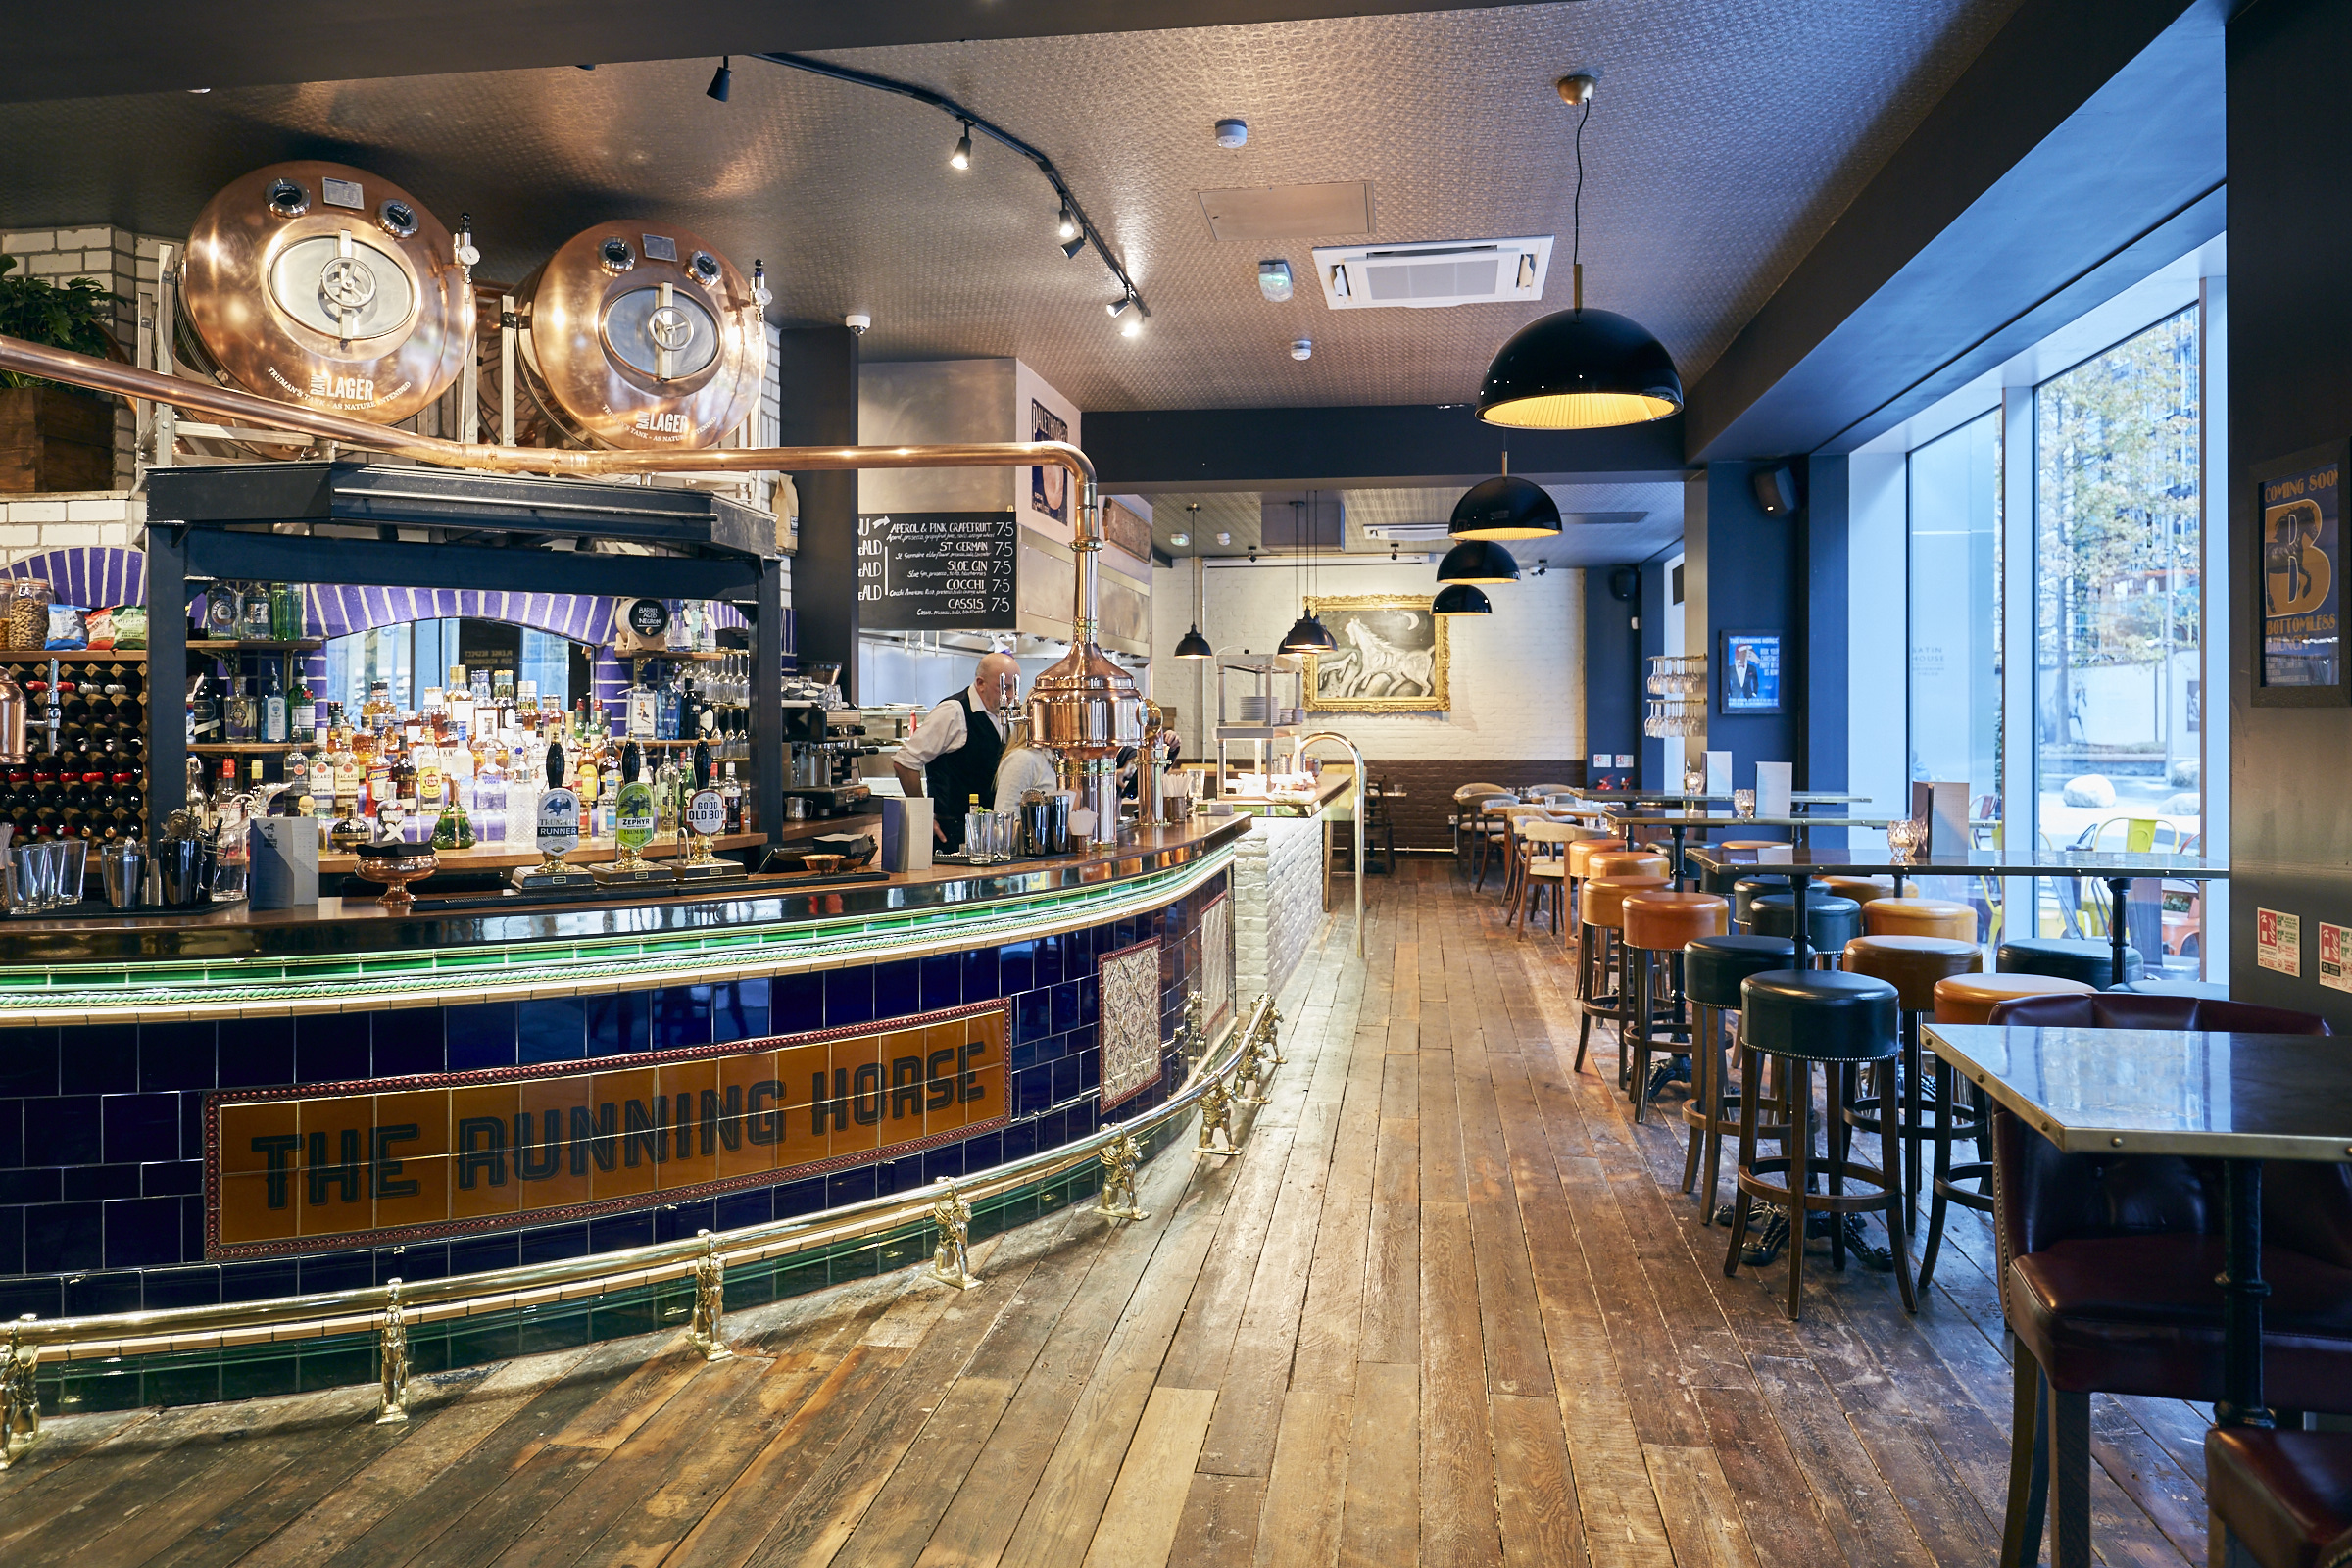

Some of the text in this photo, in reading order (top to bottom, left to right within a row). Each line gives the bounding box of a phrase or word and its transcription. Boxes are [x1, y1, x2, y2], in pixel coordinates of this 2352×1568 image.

[268, 366, 303, 398] TRUMAN'S
[304, 394, 325, 407] TANK
[344, 402, 376, 411] NATURE
[378, 380, 412, 406] INTENDED
[310, 373, 326, 396] RAW
[326, 375, 374, 401] LAGER
[635, 410, 651, 430] RAW
[649, 412, 689, 433] LAGER
[630, 428, 649, 439] TANK
[2265, 478, 2305, 503] COMING
[890, 523, 919, 533] APEROL
[921, 522, 927, 532] &
[929, 522, 947, 533] PINK
[949, 522, 992, 532] GRAPEFRUIT
[939, 542, 953, 552] ST
[956, 541, 988, 551] GERMAN
[947, 560, 969, 571] SLOE
[971, 560, 988, 571] GIN
[946, 578, 985, 590] COCCHI
[948, 598, 984, 610] CASSIS
[2266, 613, 2336, 636] BOTTOMLESS
[2265, 634, 2309, 653] BRUNCH
[697, 801, 718, 809] GOOD
[688, 809, 725, 821] OLD BOY
[250, 1041, 986, 1210] THE RUNNING HORSE
